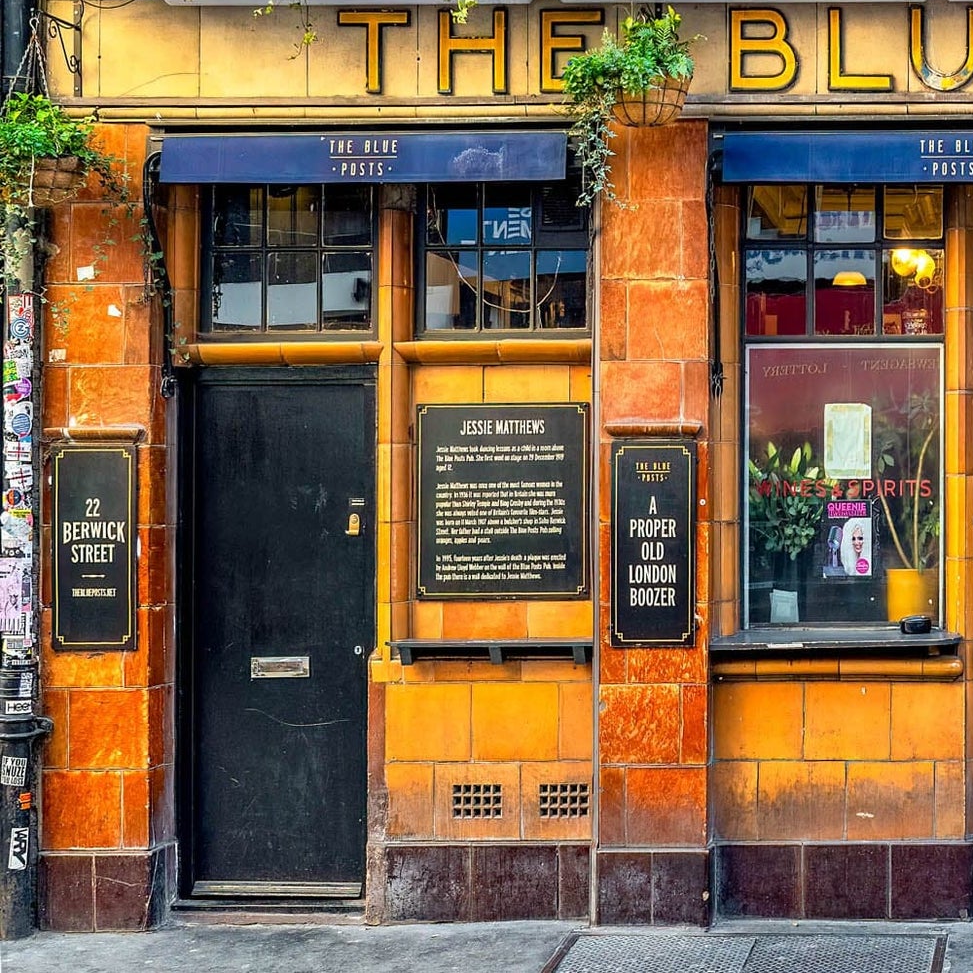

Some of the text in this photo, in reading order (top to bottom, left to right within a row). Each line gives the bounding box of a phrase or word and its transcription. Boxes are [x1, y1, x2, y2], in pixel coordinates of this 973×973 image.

[337, 7, 605, 95] THE
[329, 139, 398, 154] THE BLUE
[920, 139, 945, 155] THE
[341, 161, 384, 177] POSTS
[460, 419, 545, 436] JESSIE MATTHEWS
[635, 461, 648, 470] THE
[756, 479, 931, 498] WINES & SPIRITS
[85, 498, 100, 518] 22
[649, 495, 657, 515] A
[828, 503, 866, 512] QUEENIE
[63, 521, 126, 544] BERWICK
[630, 519, 676, 538] PROPER
[71, 544, 115, 563] STREET
[641, 541, 664, 561] OLD
[629, 565, 676, 584] LONDON
[630, 588, 676, 607] BOOZER
